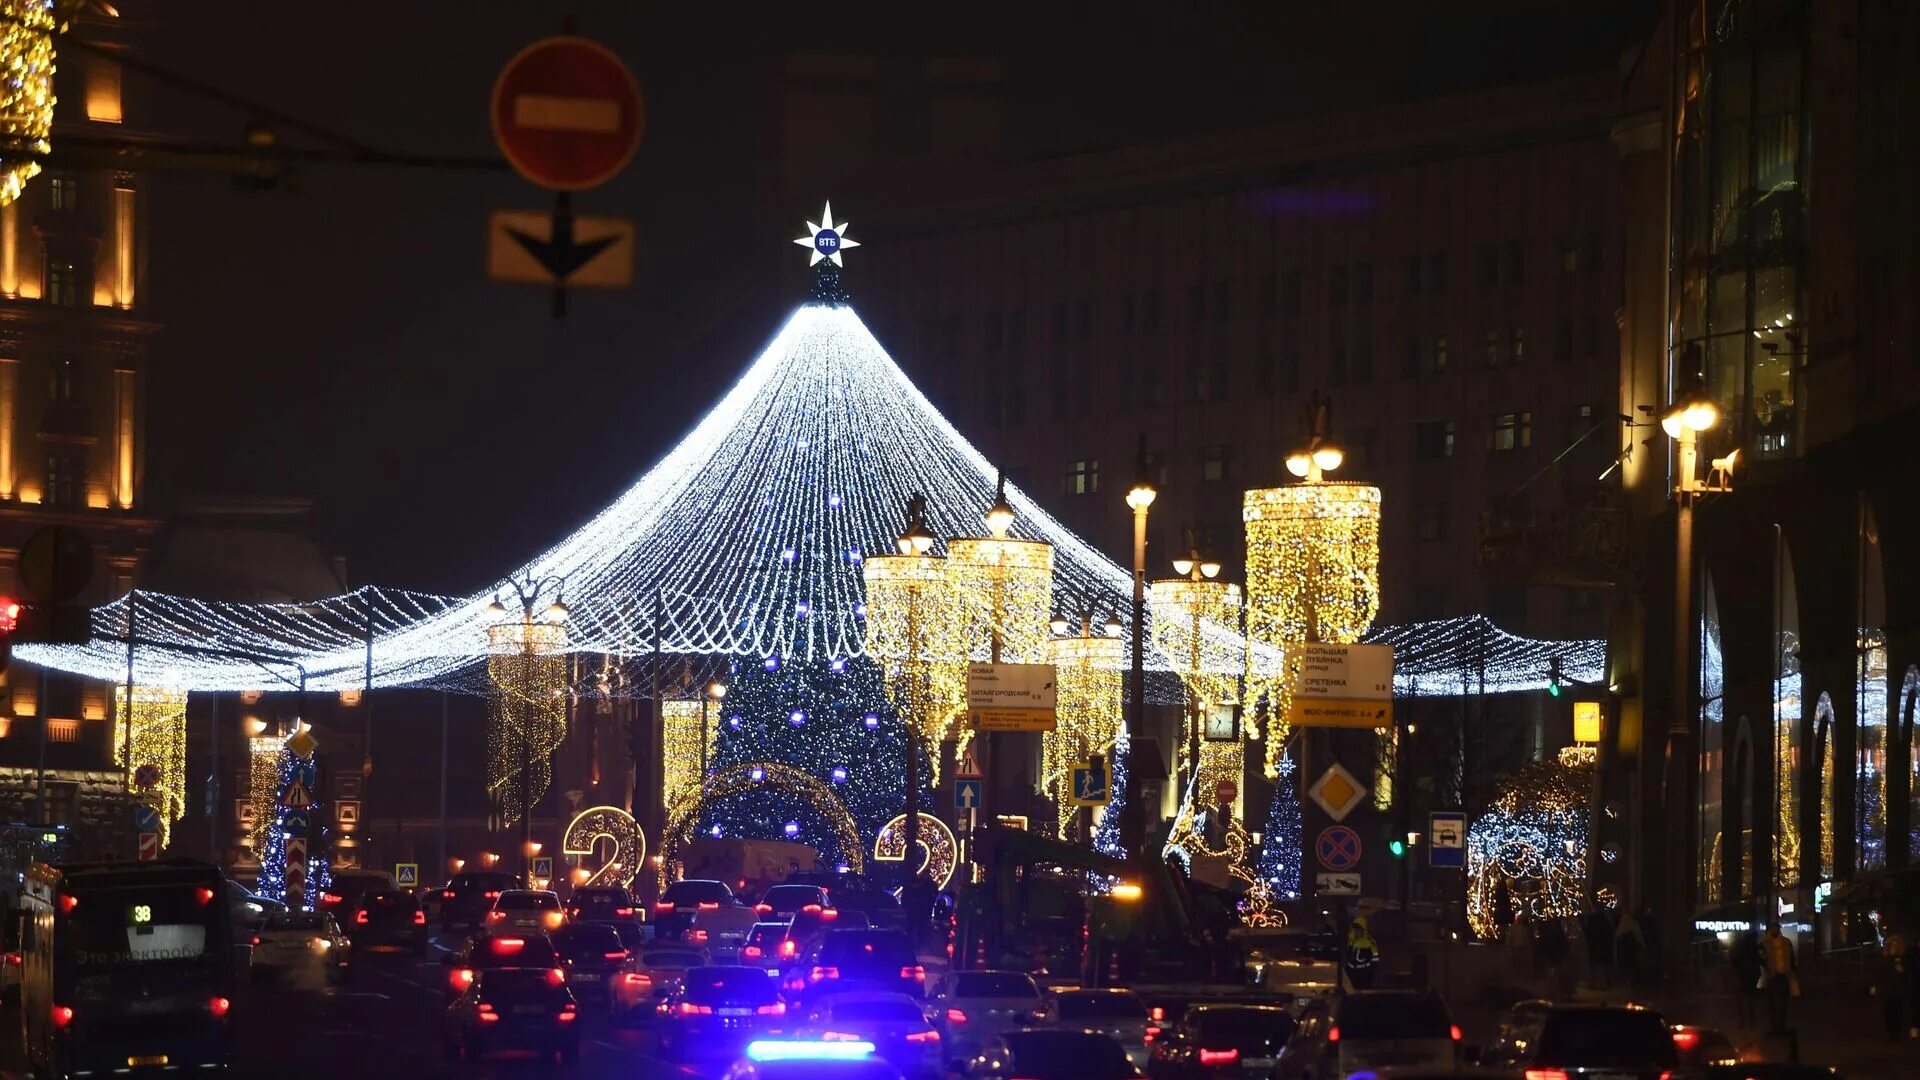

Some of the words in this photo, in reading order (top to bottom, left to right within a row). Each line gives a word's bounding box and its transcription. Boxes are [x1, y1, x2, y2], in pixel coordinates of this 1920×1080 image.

[818, 238, 836, 247] ВТБ
[1306, 647, 1348, 656] БОЛЬШАЯ
[1305, 678, 1347, 686] СРЕТЕНКА
[1695, 921, 1750, 932] ПРОДУКТЫ
[76, 949, 108, 965] Это
[113, 944, 214, 967] электробу
